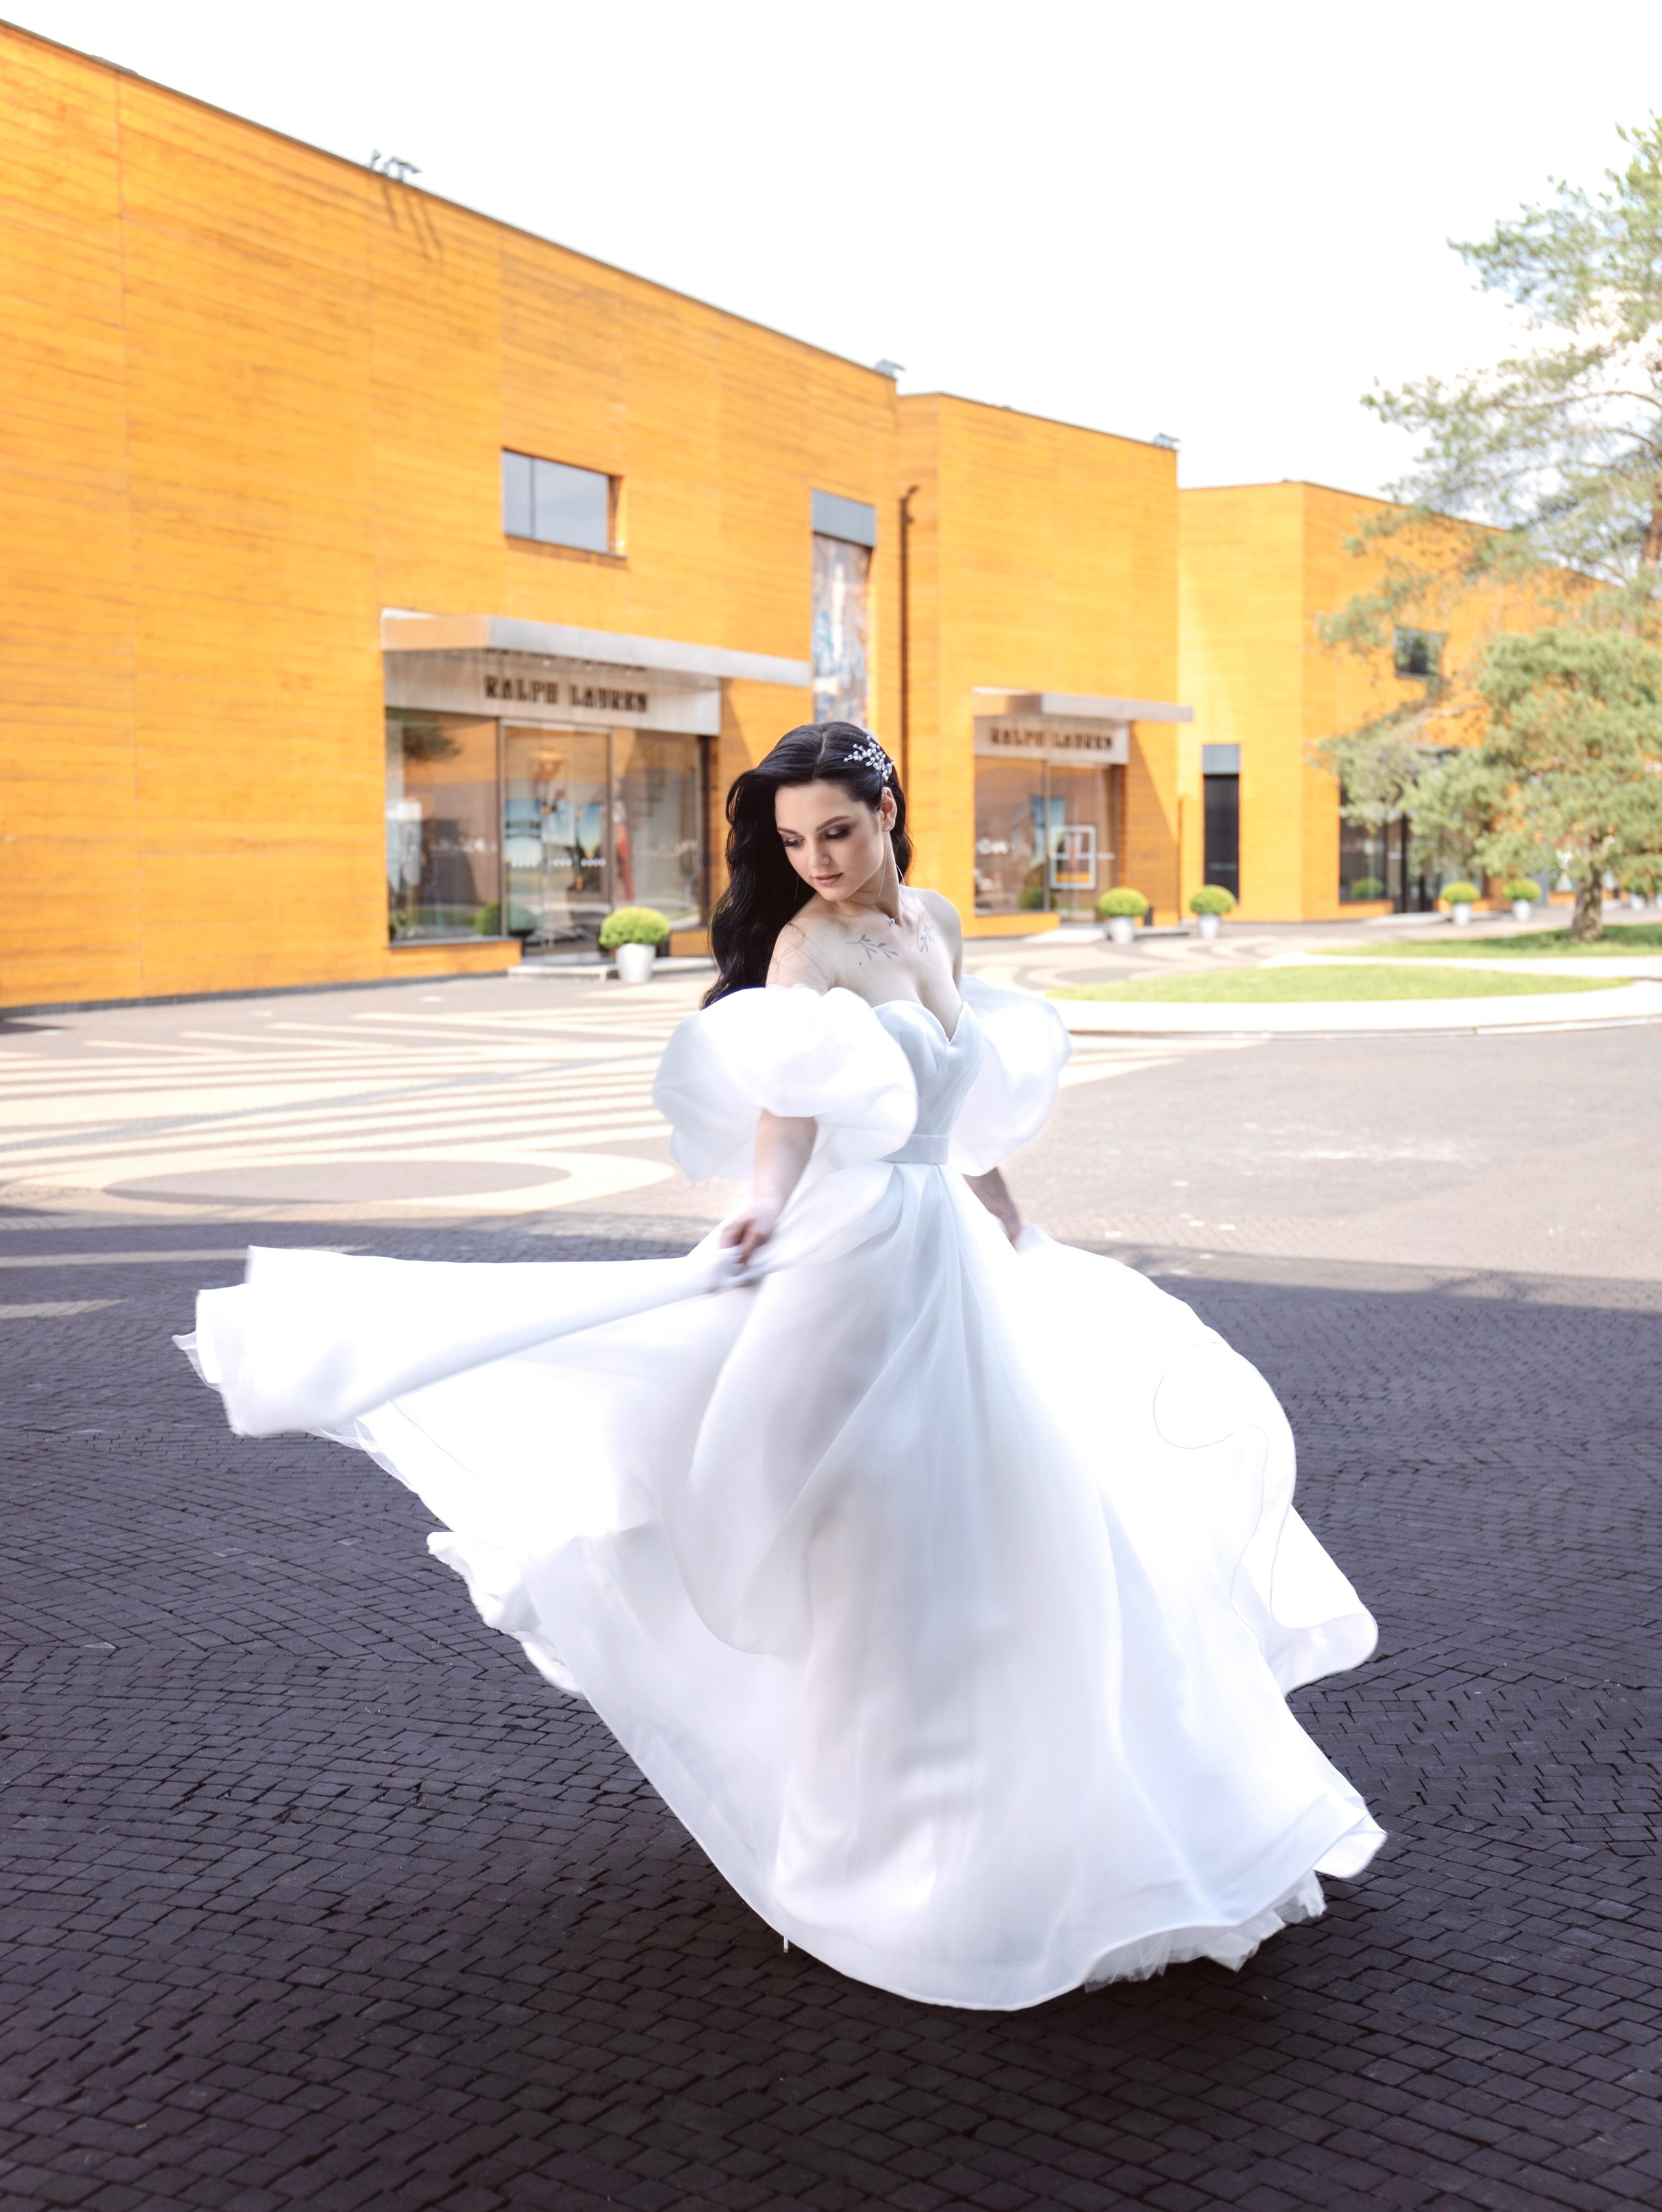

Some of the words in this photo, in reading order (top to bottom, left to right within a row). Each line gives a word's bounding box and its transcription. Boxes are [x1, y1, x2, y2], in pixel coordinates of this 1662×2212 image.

[485, 675, 558, 704] RALPH
[569, 684, 647, 713] LAUREN
[991, 727, 1044, 746] RALPH
